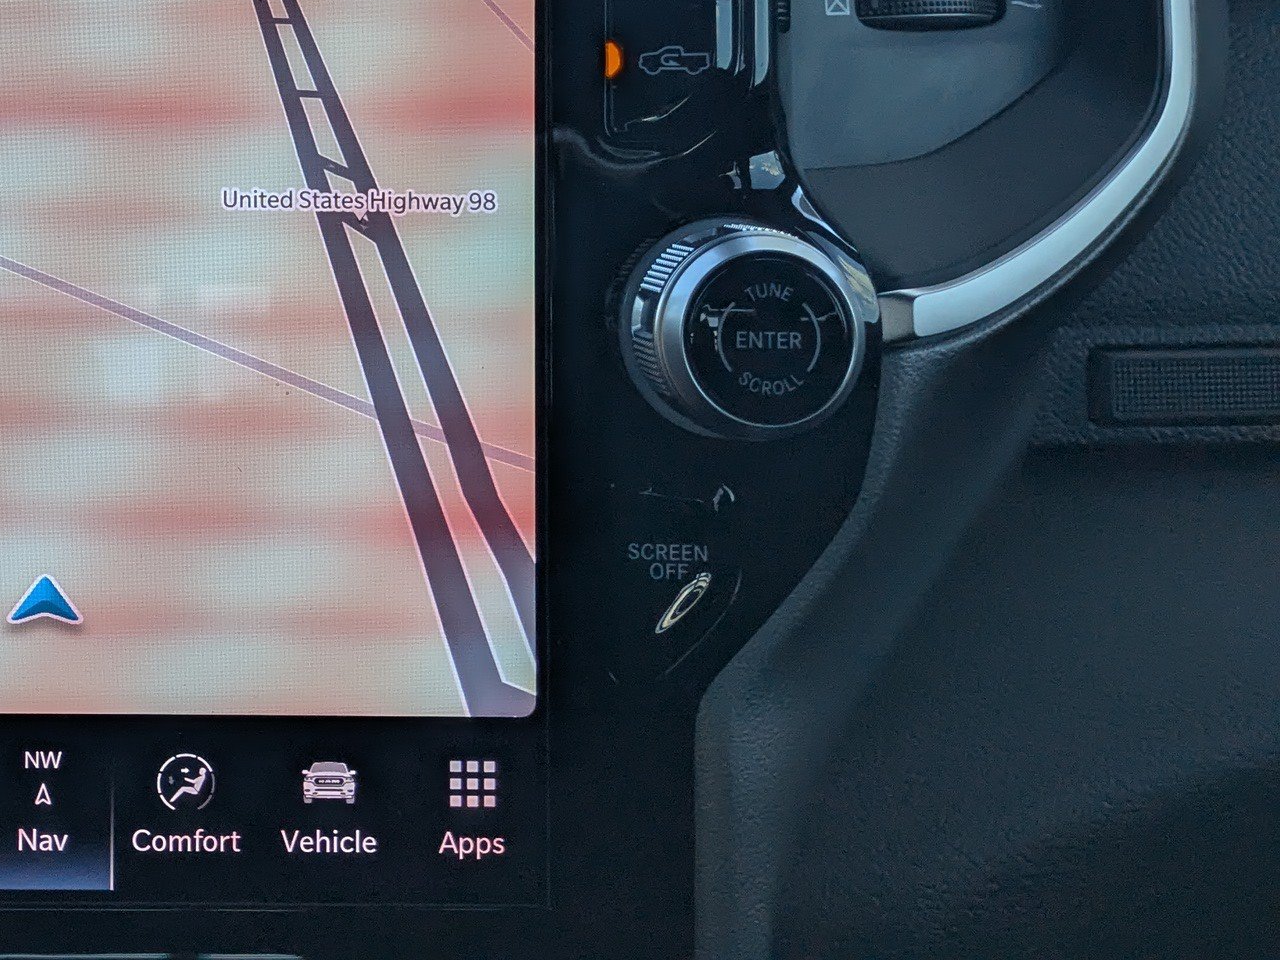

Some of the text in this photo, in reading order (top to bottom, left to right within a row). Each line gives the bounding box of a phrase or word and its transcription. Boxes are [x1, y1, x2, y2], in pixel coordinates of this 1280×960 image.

[223, 191, 497, 215] United States Highway 98
[744, 282, 794, 303] TUNE
[736, 332, 802, 350] ENTER
[738, 372, 805, 397] SCROLL
[628, 543, 709, 562] SCREEN
[649, 562, 689, 580] OFF
[23, 751, 62, 769] NW
[19, 829, 68, 852] Nav
[132, 829, 241, 853] Comfort
[281, 829, 377, 853] Vehicle
[439, 830, 505, 860] Apps
